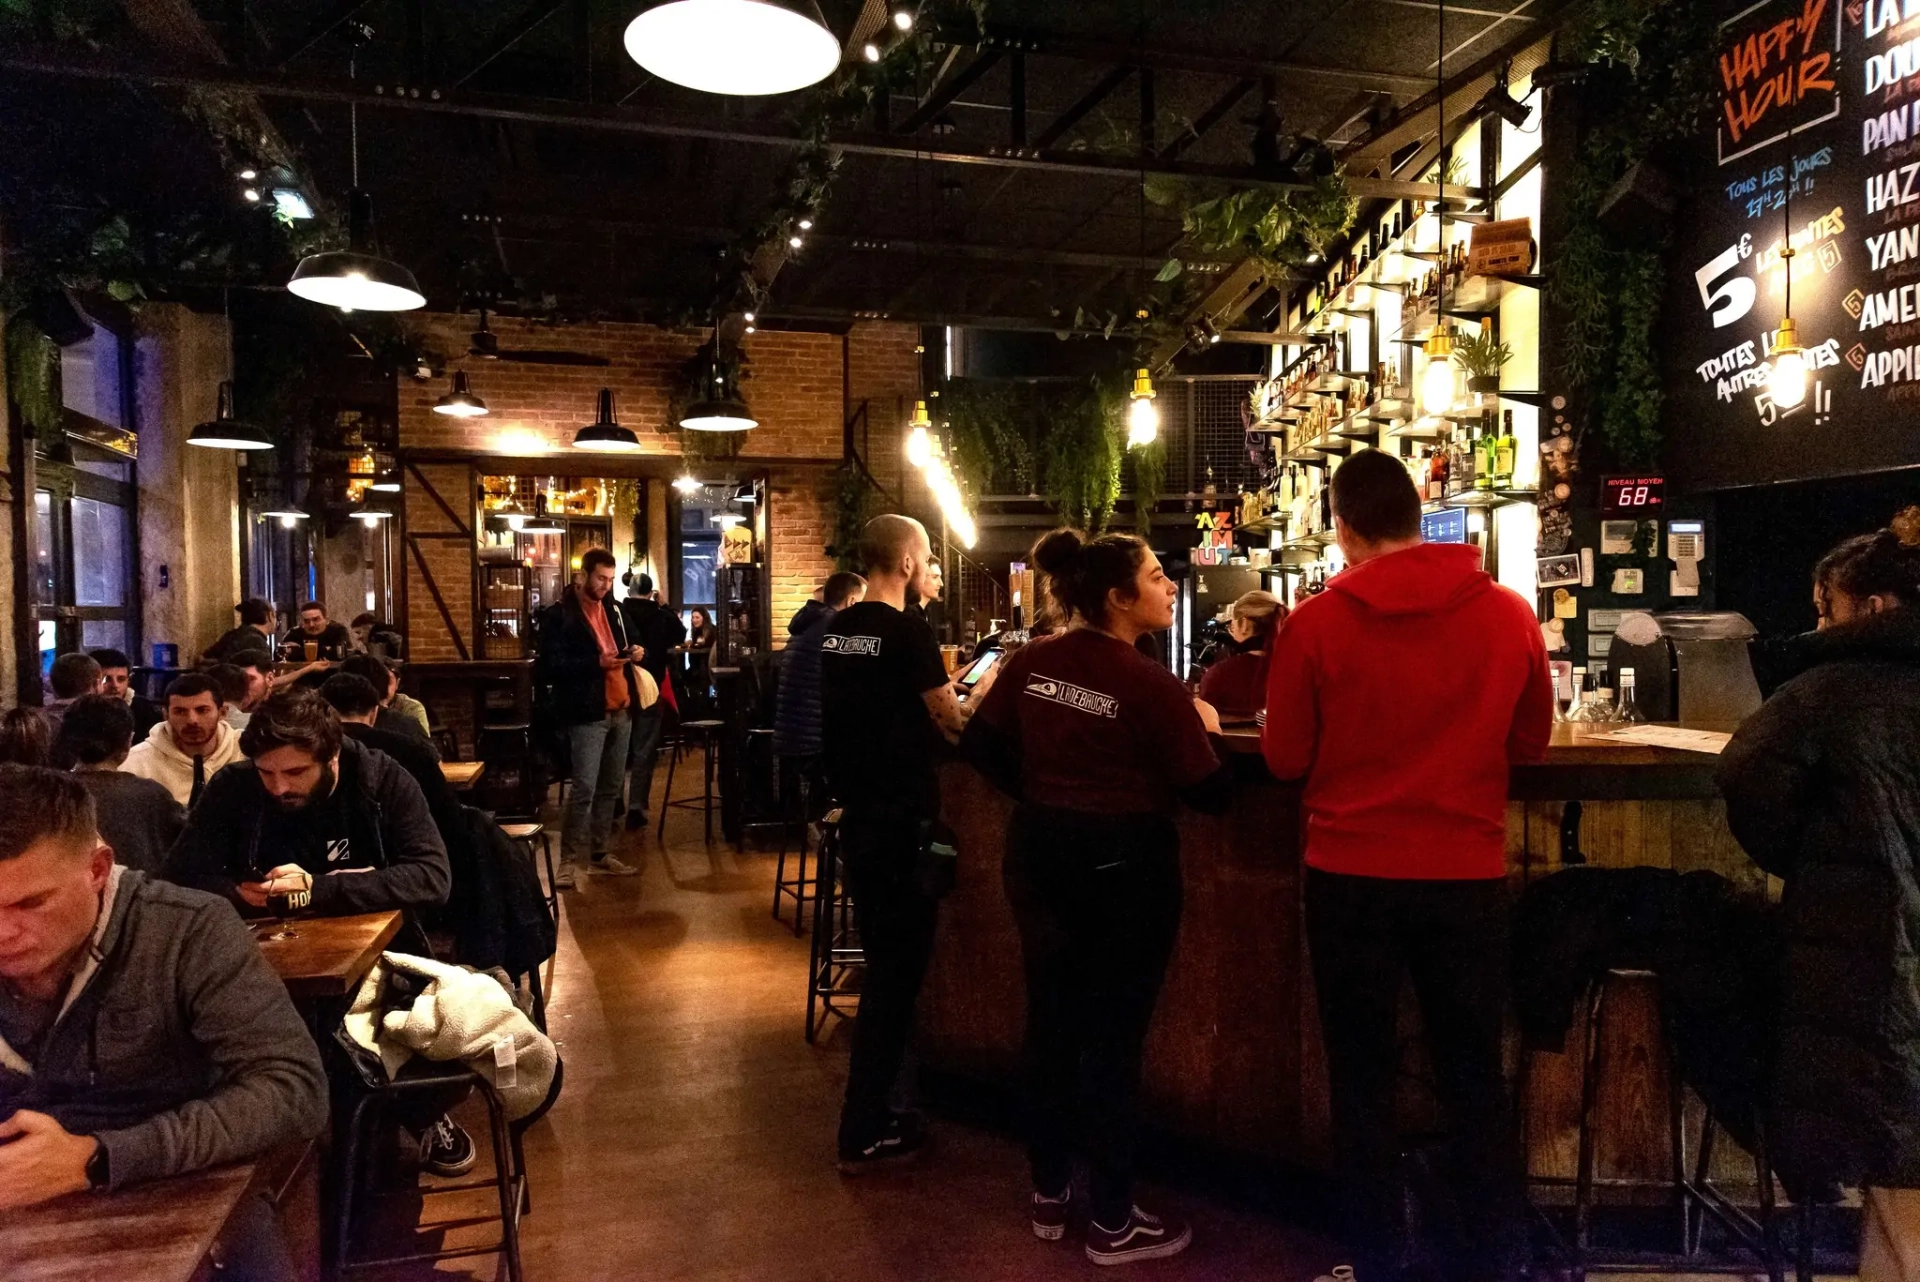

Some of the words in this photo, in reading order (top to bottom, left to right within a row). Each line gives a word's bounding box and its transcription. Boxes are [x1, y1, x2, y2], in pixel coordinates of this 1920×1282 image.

[1720, 0, 1826, 91] HAPPY
[1724, 52, 1835, 143] HOUR
[1863, 103, 1909, 155] PAN
[1761, 165, 1784, 188] LES
[1866, 161, 1920, 214] HAZ
[1865, 224, 1920, 272] YAN
[1696, 340, 1756, 383] TOUTES
[1619, 486, 1648, 506] 68
[1637, 477, 1663, 485] MOYEN
